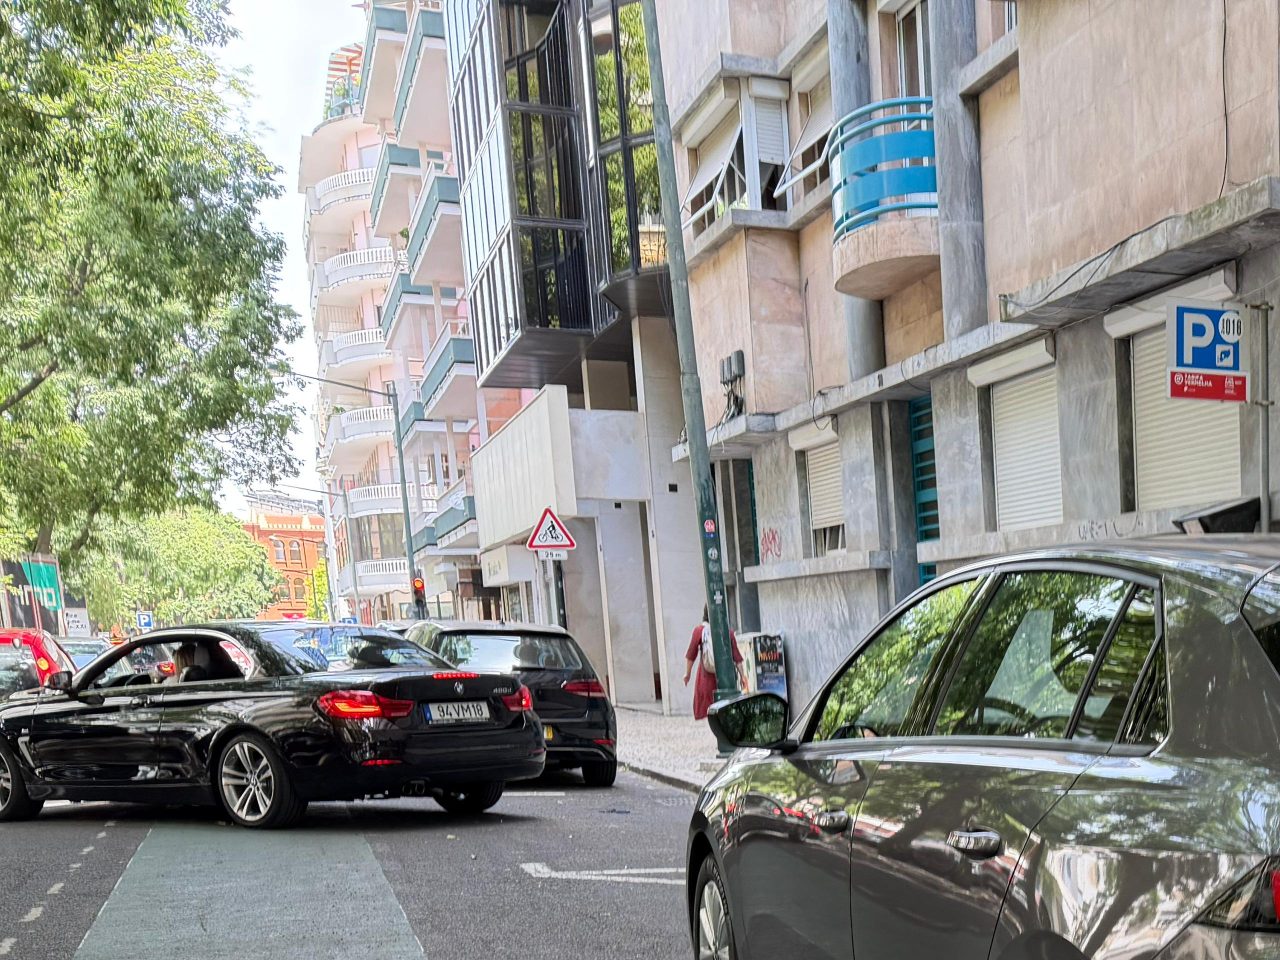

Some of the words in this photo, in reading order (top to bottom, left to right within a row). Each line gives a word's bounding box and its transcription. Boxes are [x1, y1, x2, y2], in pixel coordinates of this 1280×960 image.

[1183, 312, 1215, 365] P
[140, 614, 150, 626] P
[437, 702, 484, 718] 94VM18
